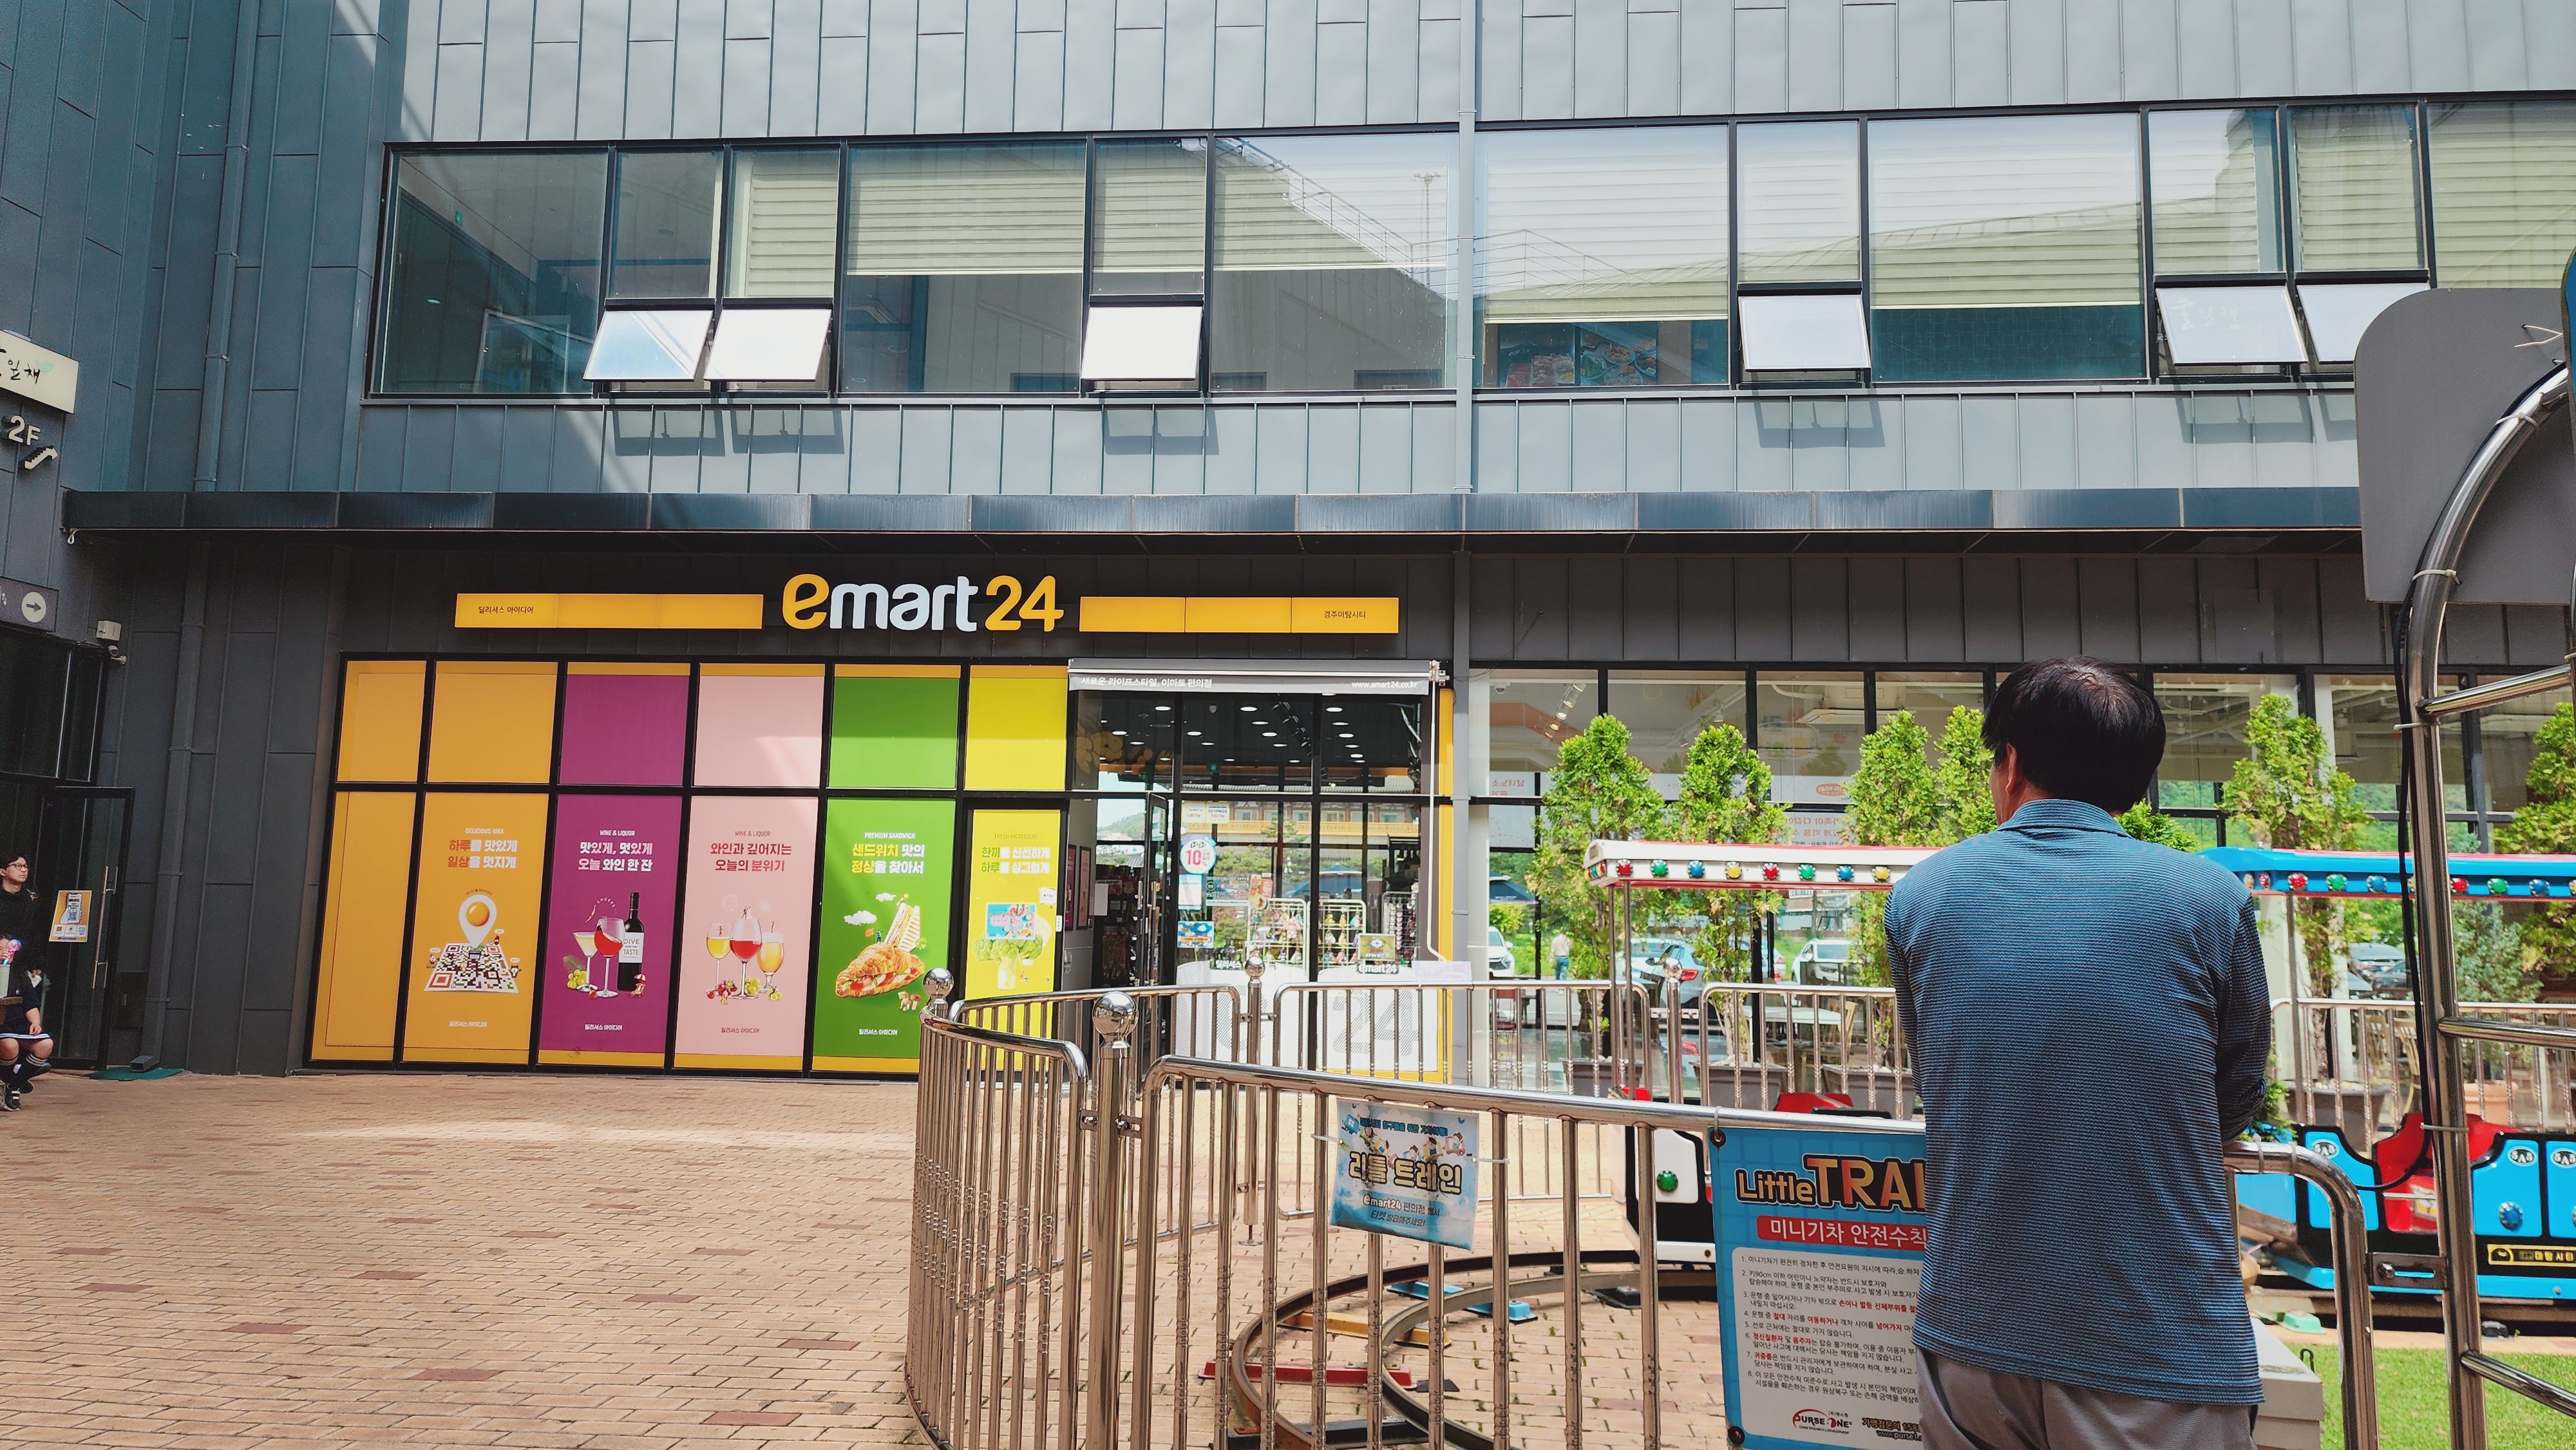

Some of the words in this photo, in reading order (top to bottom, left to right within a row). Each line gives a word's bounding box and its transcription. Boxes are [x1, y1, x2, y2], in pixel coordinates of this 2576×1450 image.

[8, 415, 41, 446] 2F
[782, 574, 1064, 632] emart24
[1081, 677, 1106, 686] 새로운
[1161, 679, 1186, 688] 이마트
[1187, 679, 1213, 688] 편의점
[449, 840, 482, 852] 하루를
[484, 840, 518, 852] 맛있게
[580, 842, 616, 854] 맛있게,
[619, 842, 653, 855] 멋있게
[710, 843, 744, 855] 와인과
[747, 843, 792, 855] 깊어지는
[852, 843, 898, 857] 샌드위치
[902, 844, 925, 857] 맛의
[1012, 847, 1050, 859] 신선하게
[448, 856, 481, 869] 일상을
[483, 856, 516, 869] 멋지게
[1186, 850, 1202, 865] 10
[578, 858, 601, 871] 오늘
[603, 858, 625, 871] 와인
[627, 858, 639, 871] 한
[641, 859, 652, 872] 잔
[715, 860, 749, 872] 오늘의
[752, 860, 785, 872] 분위기
[851, 860, 886, 874] 정상을
[889, 861, 924, 874] 찾아서
[1349, 1151, 1388, 1185] 리틀
[1394, 1158, 1463, 1196] 트레인
[1737, 1171, 1815, 1203] Little
[1806, 1157, 1926, 1209] TRAI
[1363, 1194, 1402, 1210] emart24
[1403, 1202, 1425, 1214] 편의점
[1370, 1210, 1387, 1221] 티켓
[1771, 1219, 1844, 1243] 미니기차
[1850, 1224, 1928, 1248] 안전수칙
[1748, 1256, 1778, 1265] 미니기차가
[1828, 1263, 1859, 1271] 안전요원의
[1750, 1278, 1773, 1287] 탑승해야
[1827, 1285, 1852, 1293] 부주의로
[1787, 1274, 1812, 1282] 어린이나
[1814, 1276, 1838, 1284] 노약자는
[1861, 1279, 1887, 1288] 보호자와
[1772, 1294, 1803, 1303] 일어서거나
[1839, 1299, 1858, 1308] 손이나
[1875, 1303, 1907, 1312] 신체부위를
[1752, 1310, 1764, 1319] 운행
[1773, 1312, 1785, 1321] 절대
[1787, 1314, 1805, 1323] 자리를
[1807, 1316, 1839, 1326] 이동하거나
[1855, 1320, 1874, 1329] 사이를
[1876, 1322, 1902, 1332] 넘어가지
[1766, 1323, 1790, 1332] 근처에는
[1812, 1327, 1824, 1335] 가지
[1753, 1333, 1783, 1342] 정신질환자
[1863, 1344, 1876, 1352] 이용
[1886, 1346, 1906, 1355] 이용자
[1793, 1346, 1817, 1354] 대해서는
[1819, 1348, 1838, 1356] 당사는
[1841, 1350, 1859, 1358] 책임을
[1754, 1360, 1772, 1369] 당사는
[1774, 1362, 1792, 1371] 책임을
[1780, 1355, 1799, 1363] 반드시
[1801, 1357, 1831, 1366] 관리자에게
[1833, 1361, 1865, 1370] 보관하여야
[1884, 1366, 1897, 1374] 분실
[1844, 1381, 1857, 1389] 발생
[1864, 1391, 1877, 1400] 손해
[1793, 1413, 1825, 1427] PURSE
